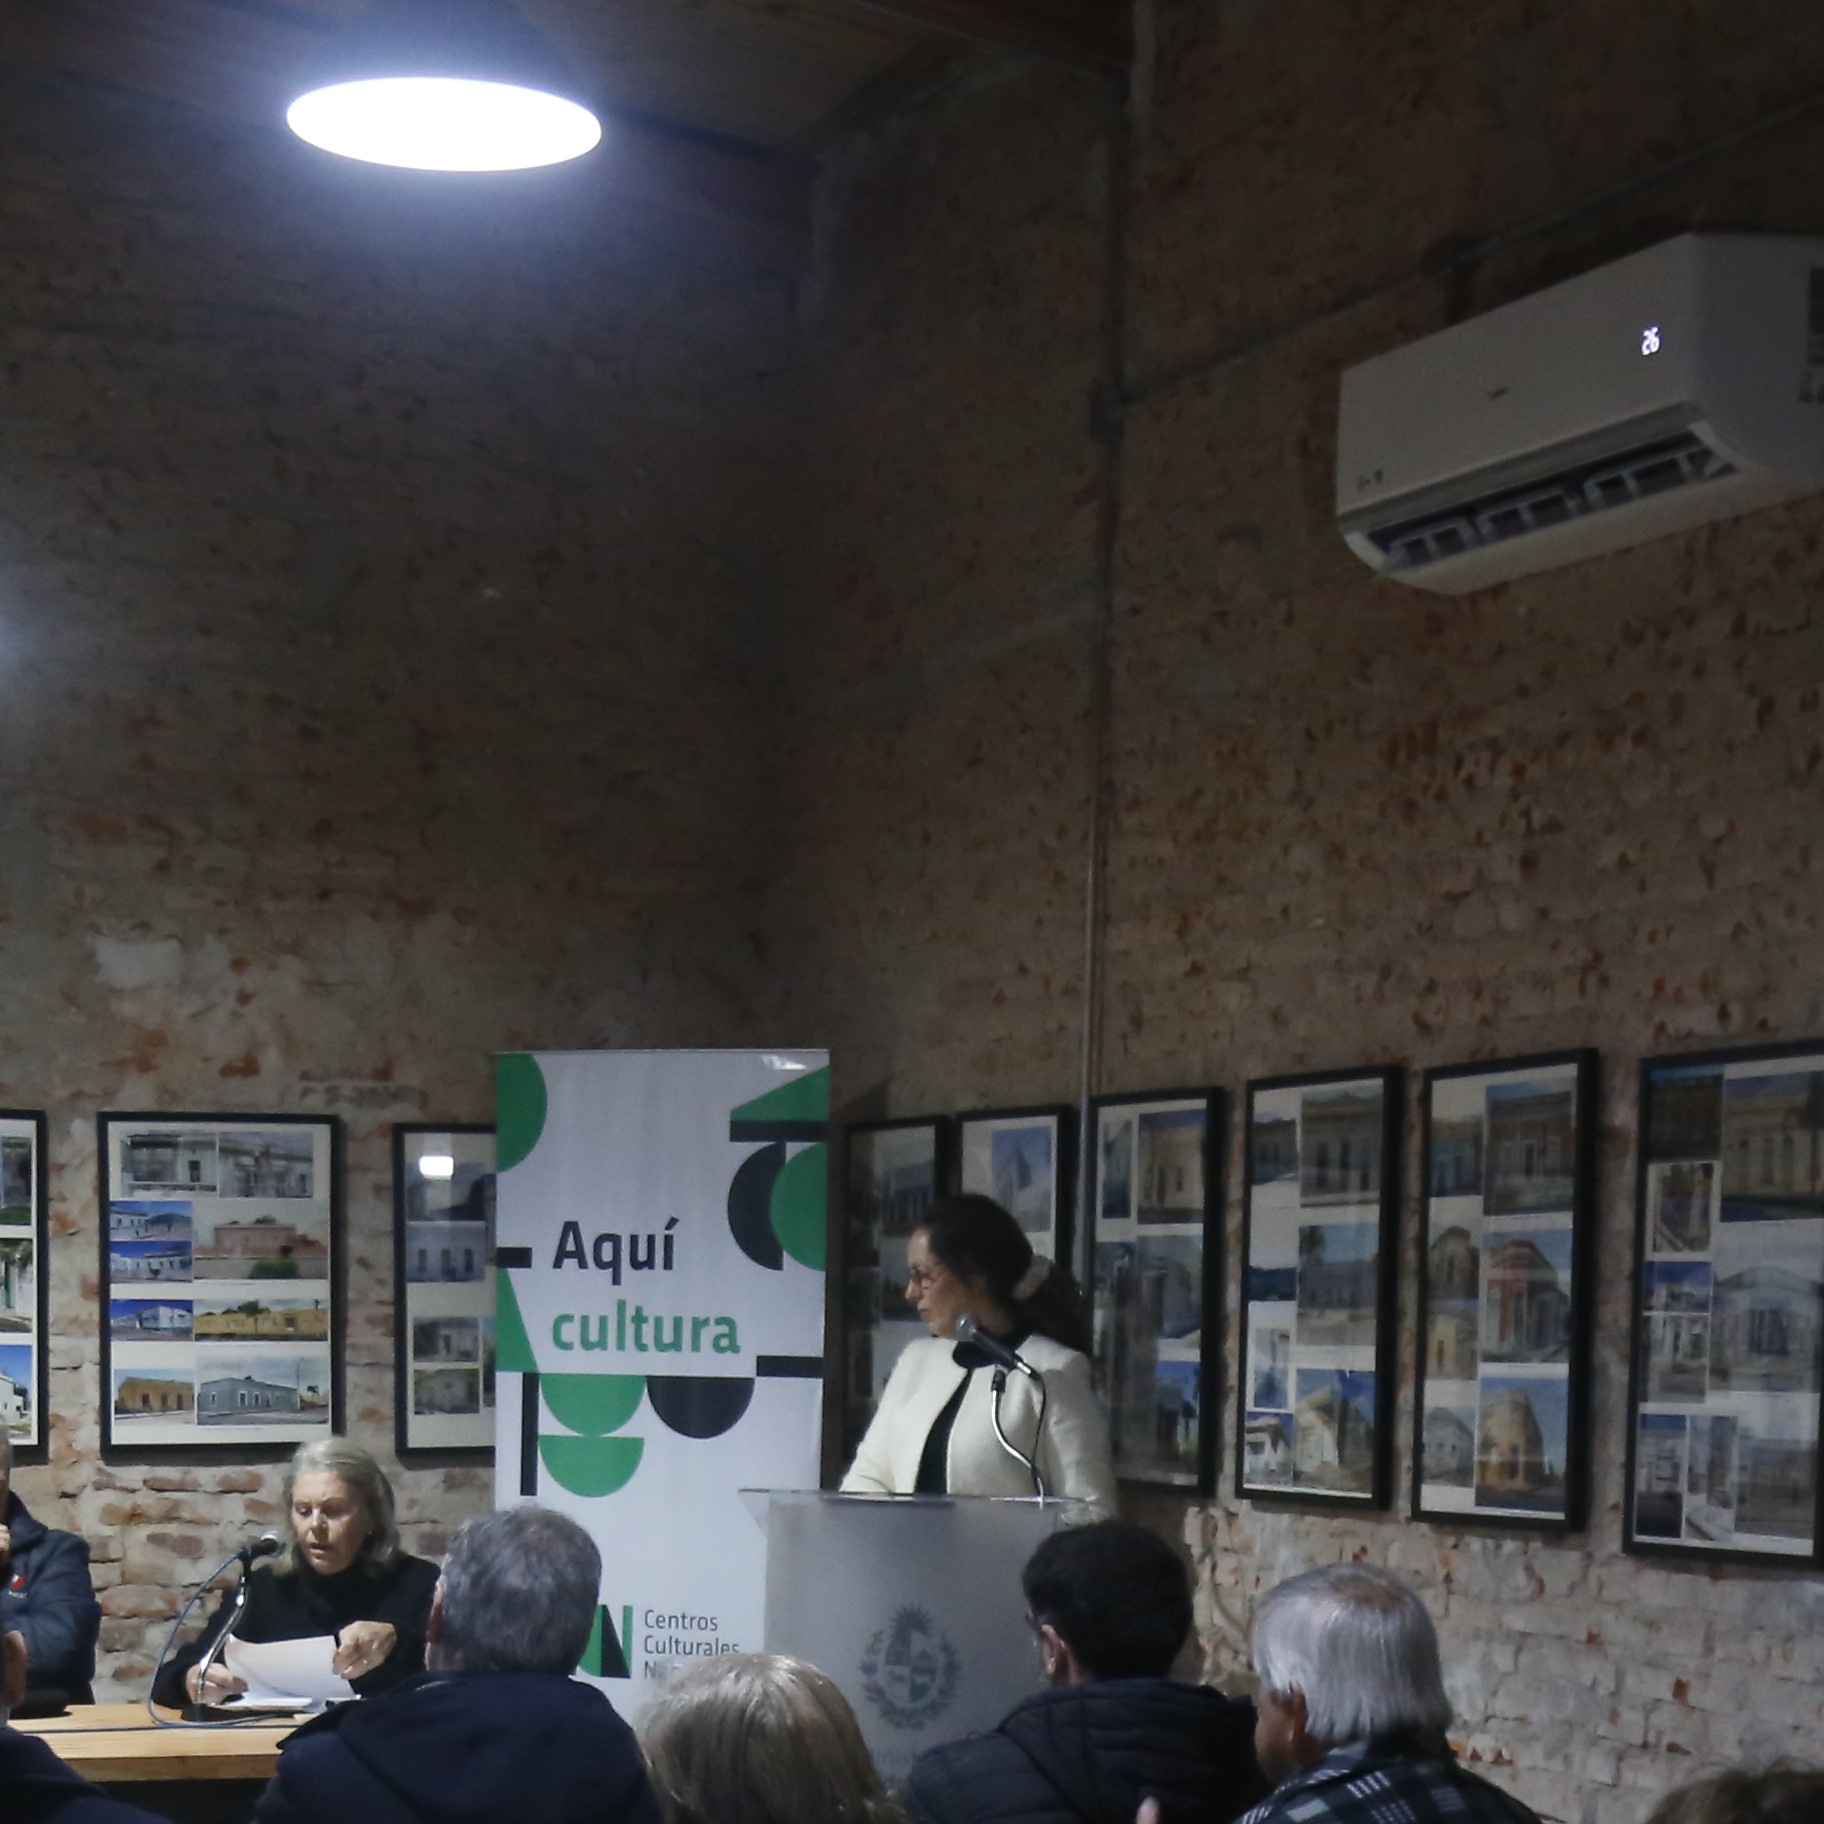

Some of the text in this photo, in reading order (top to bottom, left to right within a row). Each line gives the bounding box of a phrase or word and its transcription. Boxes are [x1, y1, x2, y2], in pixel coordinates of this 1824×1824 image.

[552, 1216, 680, 1286] Aquí
[552, 1299, 741, 1354] cultura
[644, 1609, 719, 1632] Centros
[644, 1635, 741, 1656] Culturales
